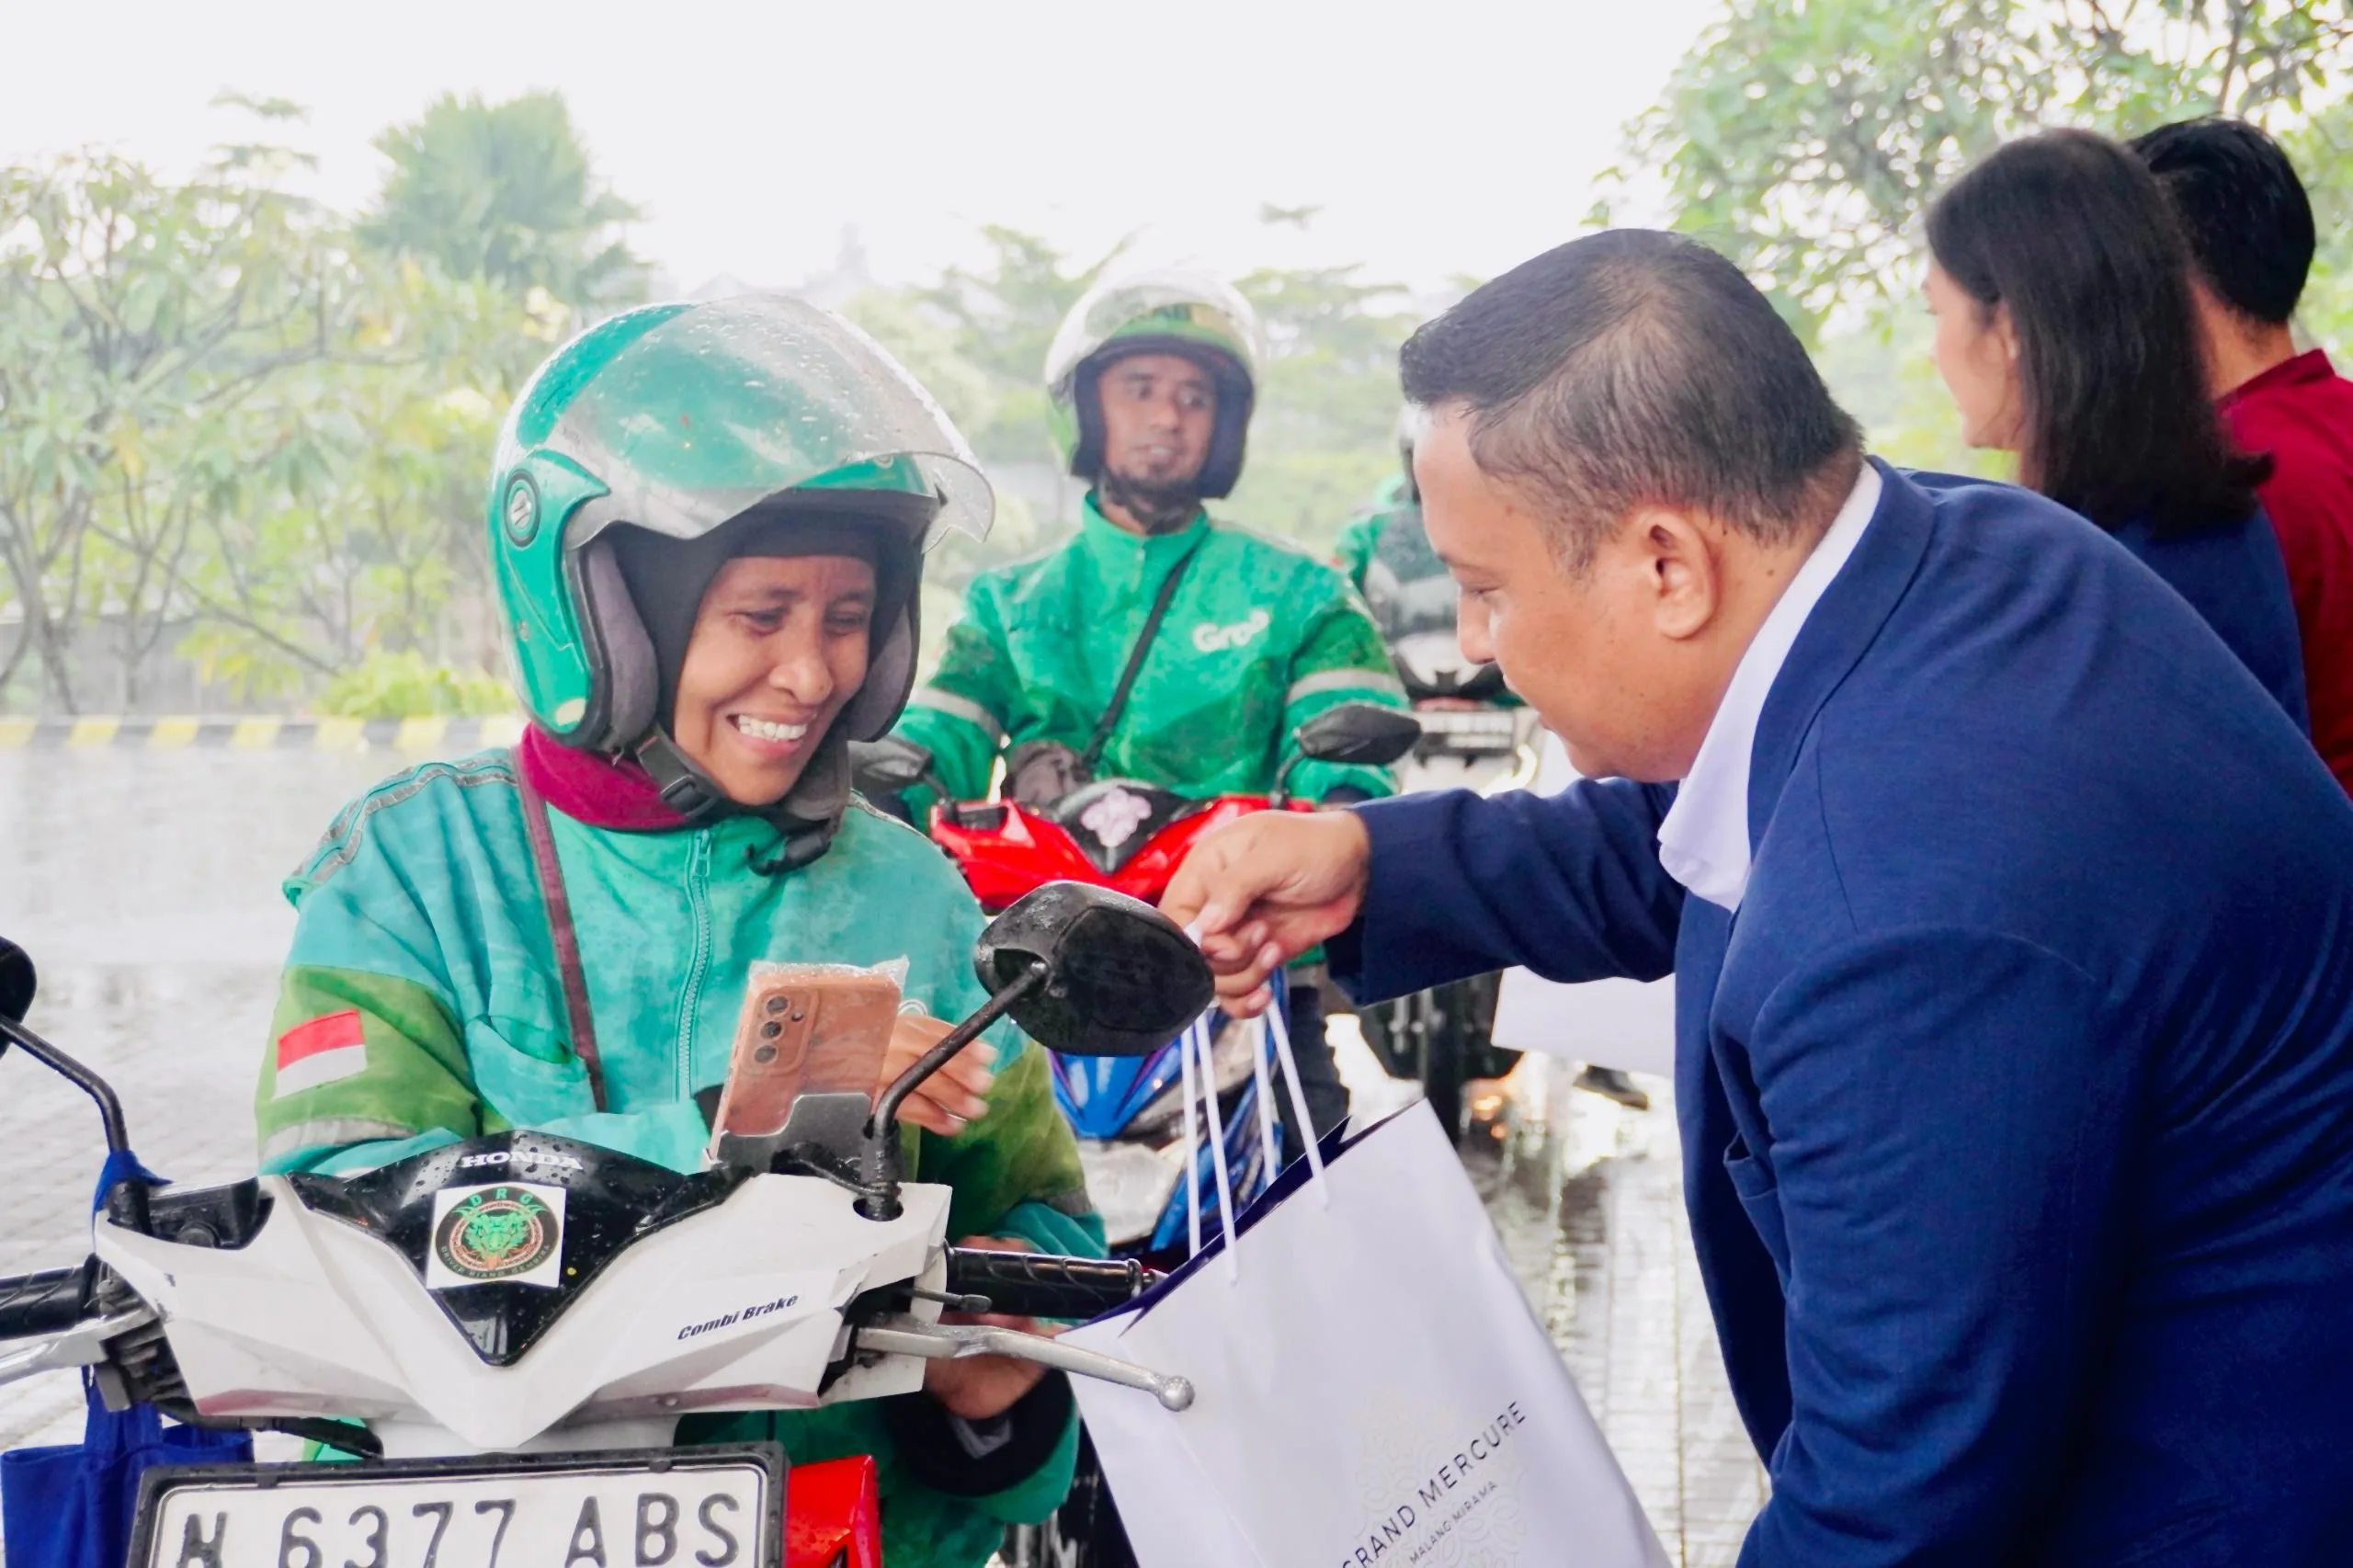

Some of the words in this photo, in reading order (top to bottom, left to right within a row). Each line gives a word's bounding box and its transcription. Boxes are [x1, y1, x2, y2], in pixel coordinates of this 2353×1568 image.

[1192, 607, 1269, 653] Grab
[460, 1152, 584, 1169] HONDA
[677, 1311, 741, 1340] Combi
[742, 1295, 799, 1321] Brake
[1418, 1400, 1526, 1508] MERCURE
[278, 1500, 516, 1568] 6377
[566, 1492, 739, 1568] ABS
[1409, 1519, 1452, 1564] MALANG
[1452, 1481, 1498, 1522] MIRAMA
